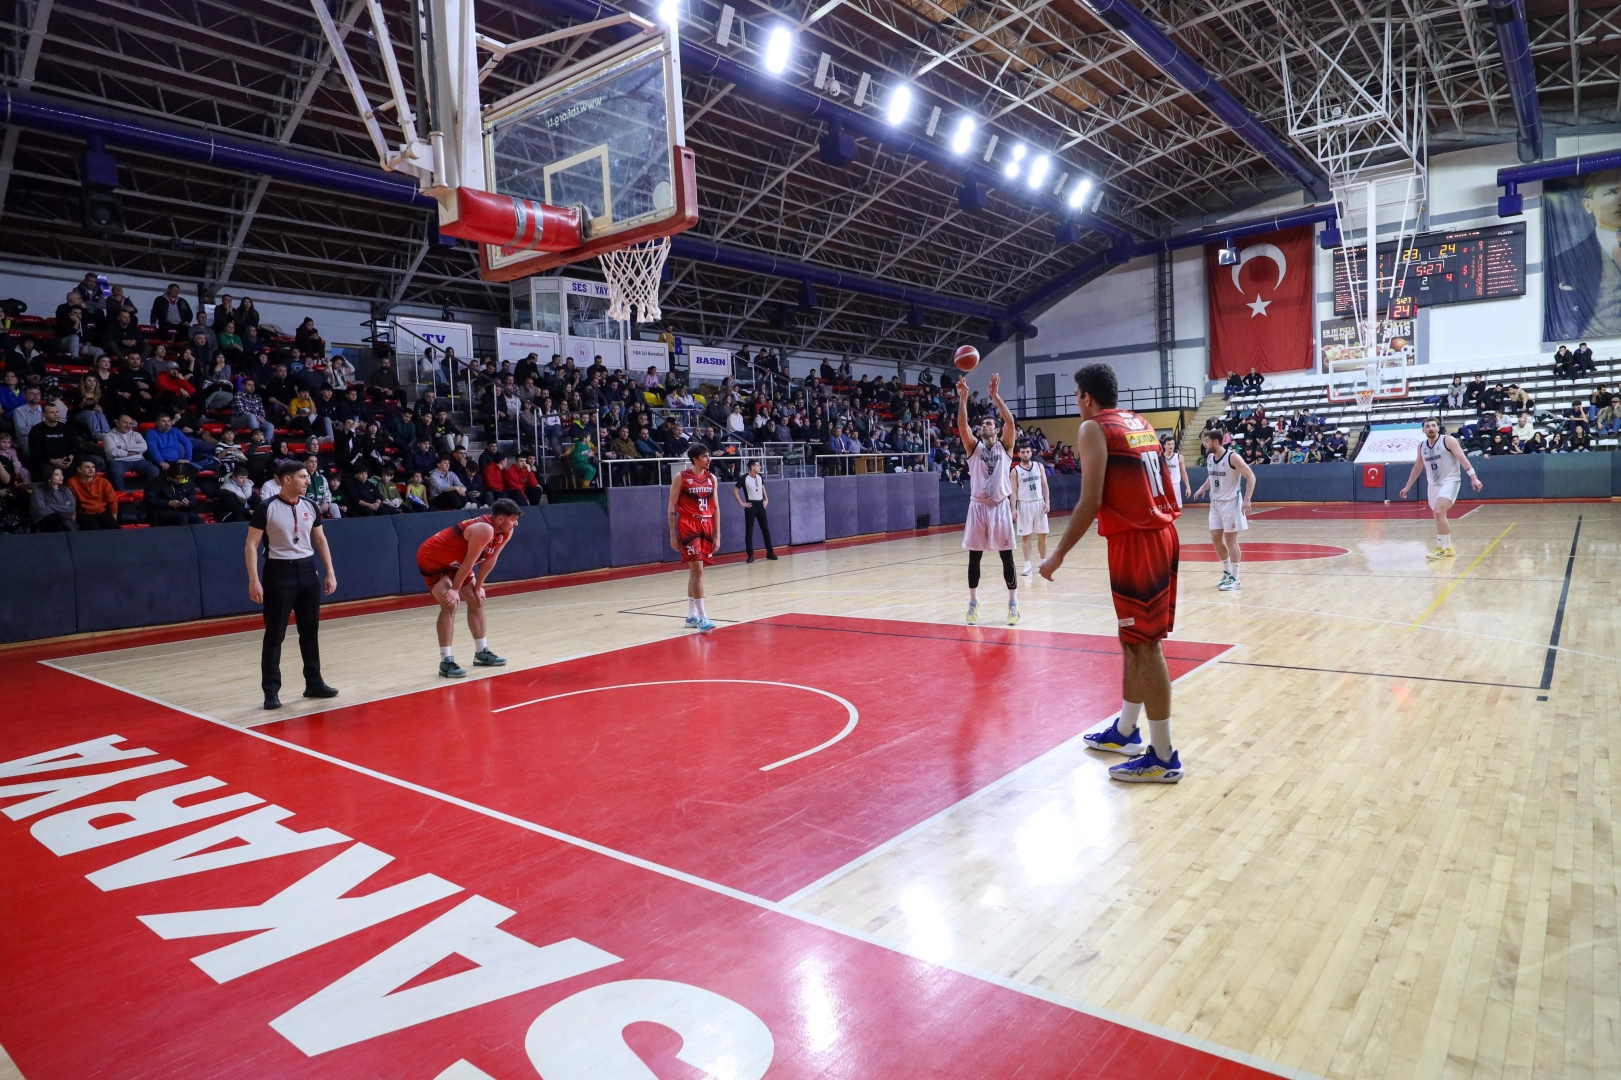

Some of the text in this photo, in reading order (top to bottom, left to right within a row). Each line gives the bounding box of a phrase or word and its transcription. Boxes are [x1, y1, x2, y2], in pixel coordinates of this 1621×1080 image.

[1403, 249, 1418, 260] 23
[1440, 244, 1455, 256] 24
[1416, 263, 1442, 276] 5:27
[1422, 277, 1427, 285] 2
[1446, 273, 1452, 281] 4
[572, 282, 587, 292] SES
[1394, 305, 1409, 317] 24
[422, 333, 446, 344] TV
[696, 356, 726, 366] BASIN
[698, 499, 707, 511] 24
[687, 545, 695, 555] 24
